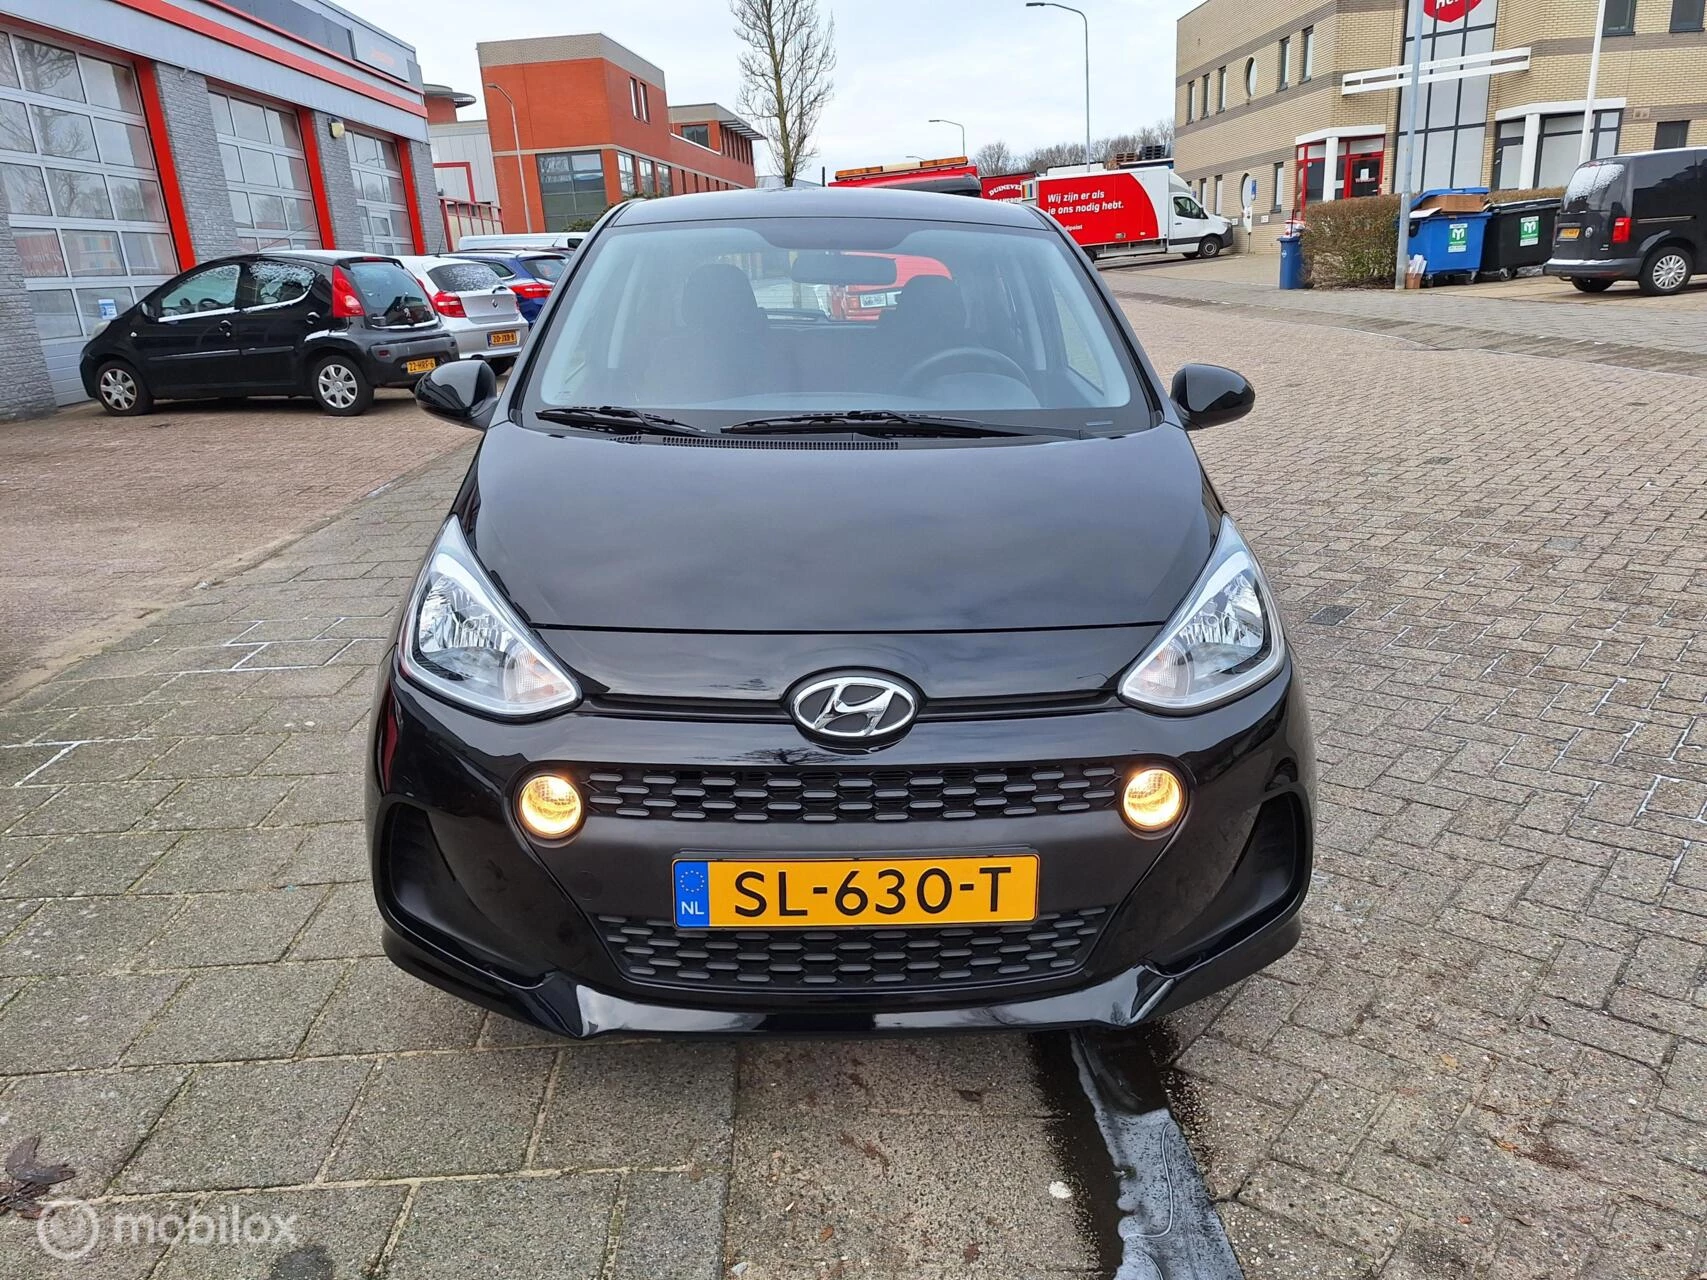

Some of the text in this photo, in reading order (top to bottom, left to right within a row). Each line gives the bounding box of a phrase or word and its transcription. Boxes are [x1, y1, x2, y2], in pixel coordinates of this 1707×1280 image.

[1047, 189, 1105, 204] Wij zijn er als
[1057, 206, 1074, 215] ons
[1075, 202, 1100, 213] nodig
[1101, 200, 1124, 210] hebt.
[734, 866, 1012, 918] SL-630-T
[681, 901, 705, 915] NL
